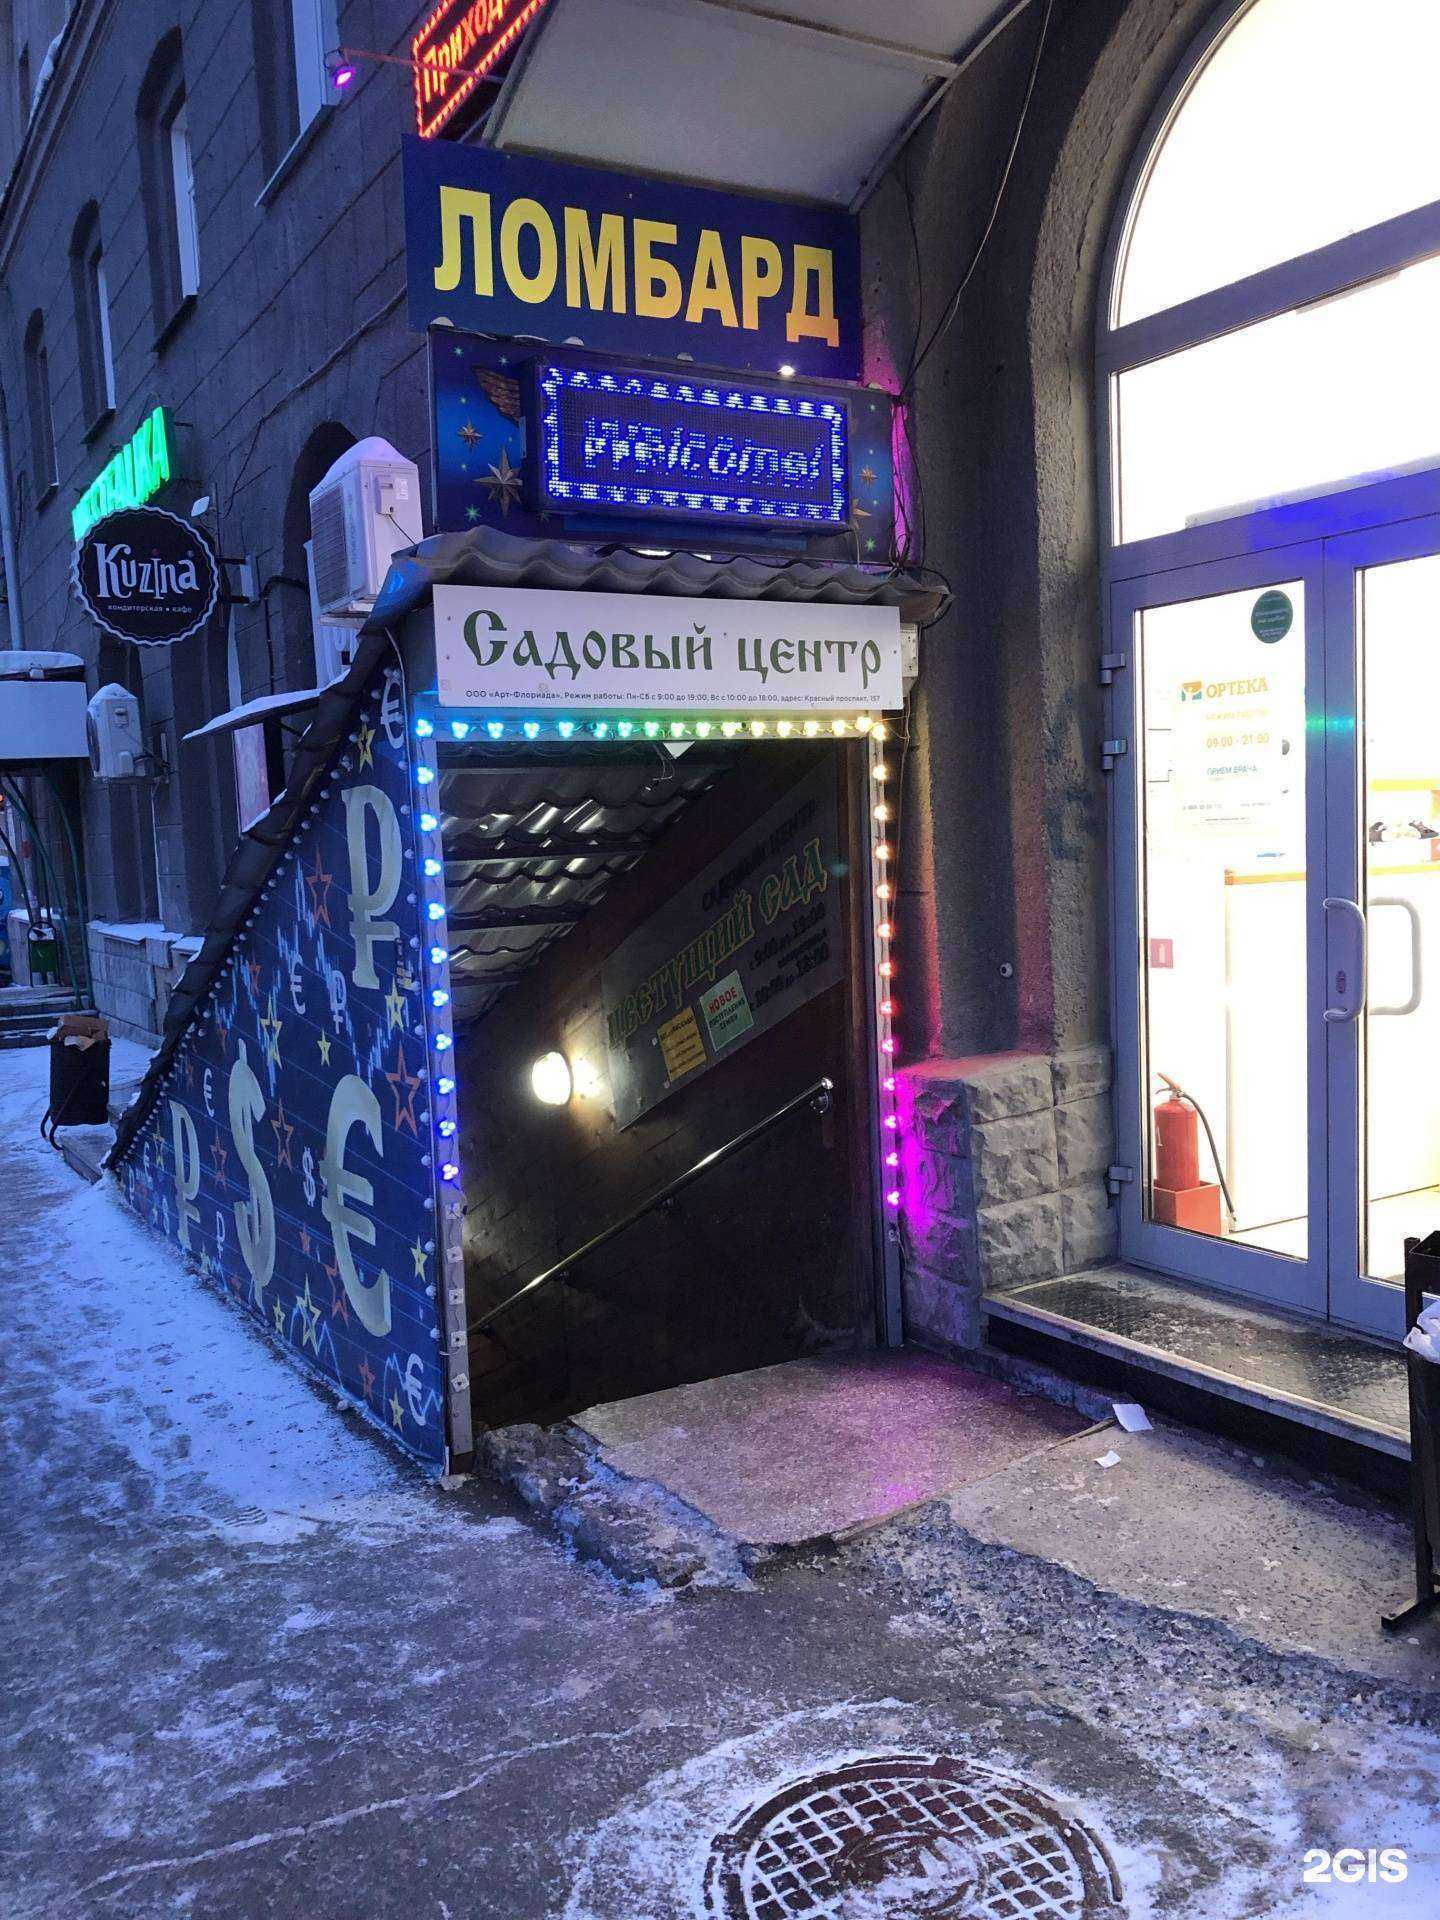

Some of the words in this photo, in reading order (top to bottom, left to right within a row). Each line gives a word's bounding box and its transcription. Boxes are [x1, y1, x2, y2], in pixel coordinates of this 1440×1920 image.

[434, 186, 839, 347] ЛОМБАРД
[172, 604, 193, 614] кафе
[465, 690, 487, 698] ООО
[564, 692, 592, 700] Режим
[593, 692, 624, 702] работы:
[626, 692, 650, 700] Пн-Сб
[676, 694, 686, 702] до
[748, 695, 758, 703] до
[708, 987, 738, 1014] НОВОЕ
